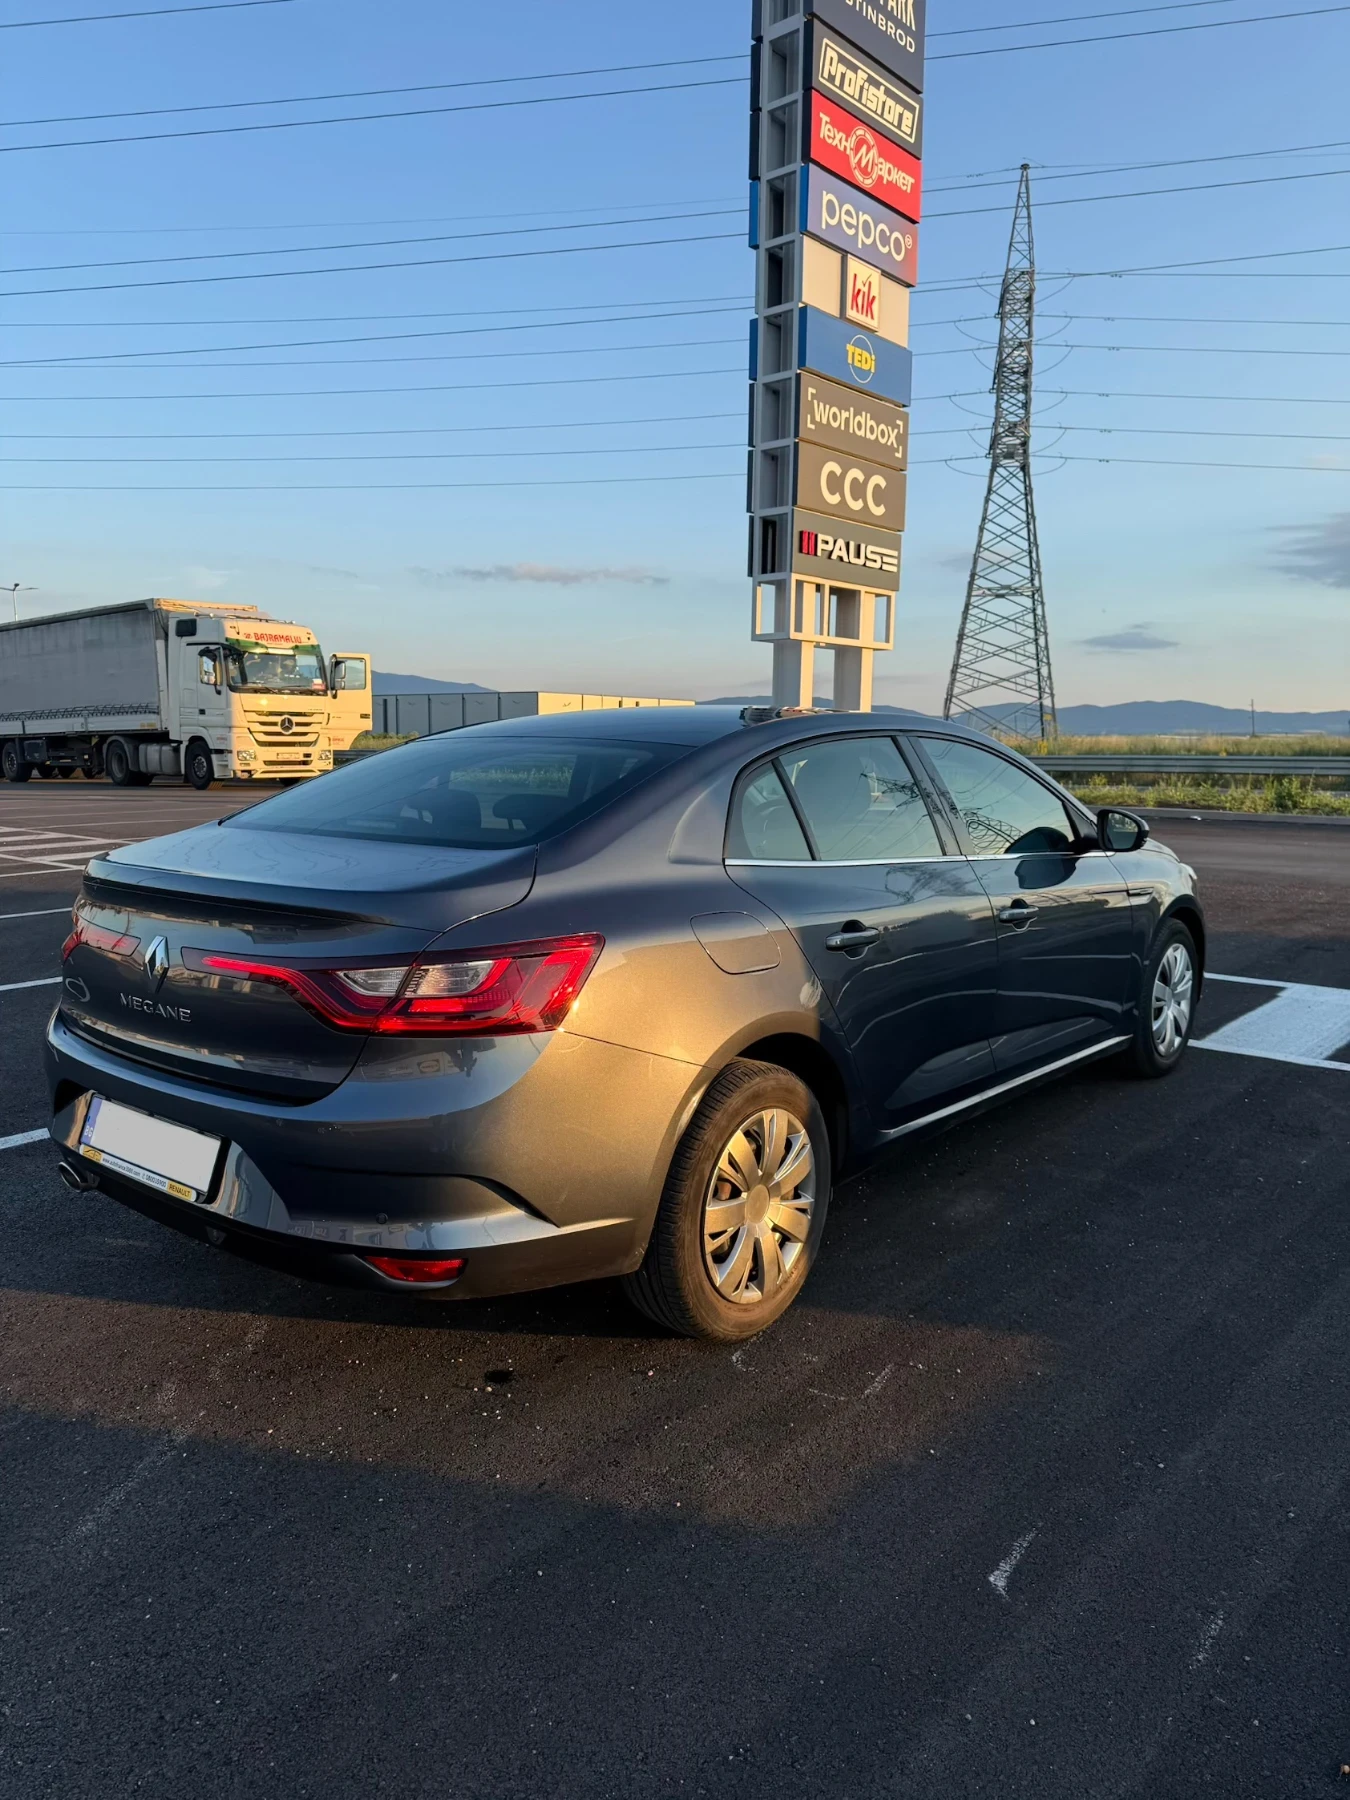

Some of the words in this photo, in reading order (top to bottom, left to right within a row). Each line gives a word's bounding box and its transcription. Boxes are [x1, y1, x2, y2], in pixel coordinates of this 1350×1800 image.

[879, 0, 916, 31] ARK
[822, 46, 913, 135] Profistore
[850, 273, 876, 321] kik
[846, 343, 876, 373] TEDi
[813, 399, 898, 448] worldbox
[820, 460, 887, 516] CCC
[816, 533, 898, 572] PAUSE
[119, 992, 192, 1023] MEGANE
[84, 1125, 94, 1138] BG
[168, 1183, 191, 1198] RENAULT
